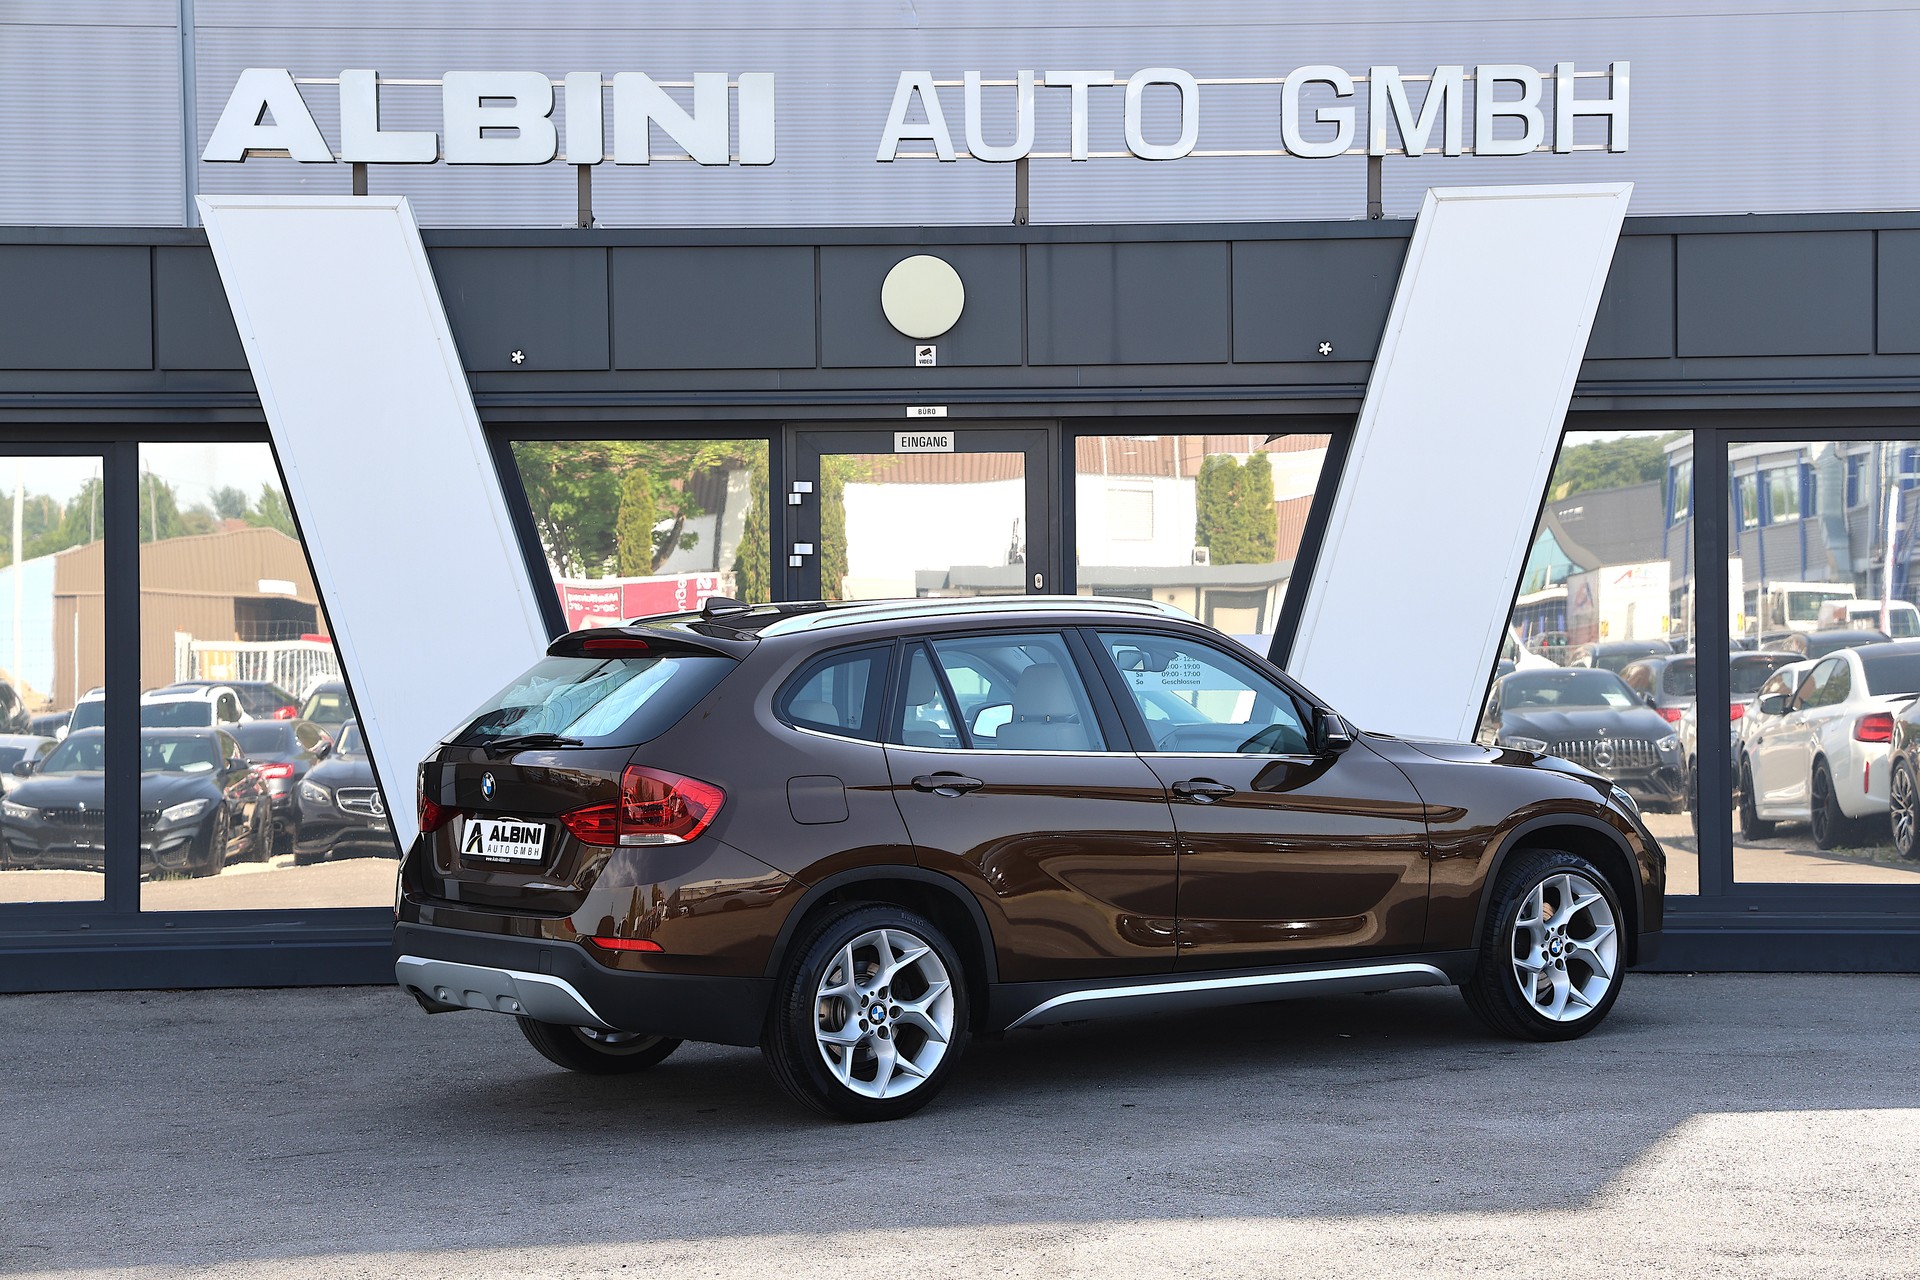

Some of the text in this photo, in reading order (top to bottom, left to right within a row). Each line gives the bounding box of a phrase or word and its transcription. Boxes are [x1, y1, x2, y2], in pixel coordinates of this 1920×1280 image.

[201, 61, 1630, 166] ALBINI AUTO GMBH
[901, 436, 948, 448] EINGANG
[489, 825, 541, 844] ALBINI
[487, 844, 539, 856] AUTO GMBH
